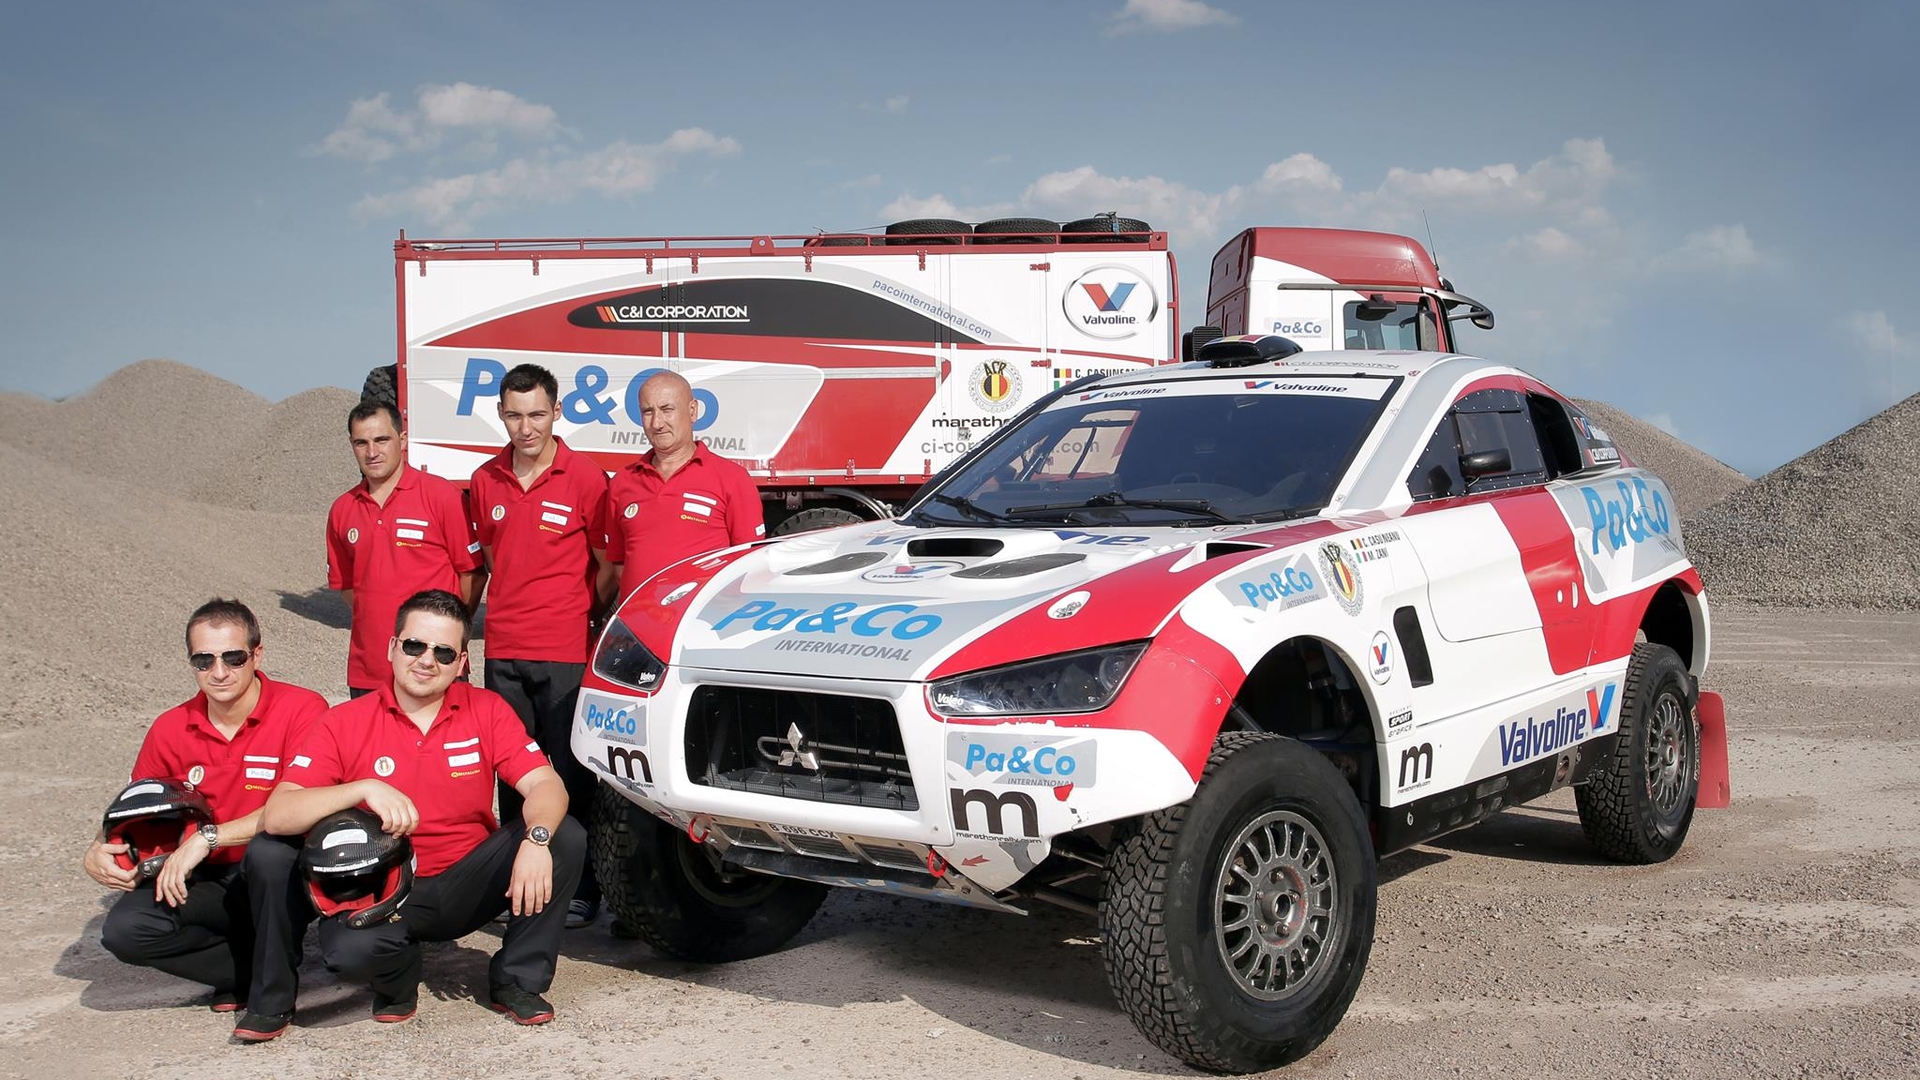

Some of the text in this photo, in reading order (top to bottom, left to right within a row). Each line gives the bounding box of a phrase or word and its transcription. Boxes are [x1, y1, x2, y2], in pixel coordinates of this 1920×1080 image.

[620, 305, 748, 319] C&I CORPORATION
[872, 278, 992, 340] pacointernational.com
[1082, 314, 1136, 326] Valvoline
[1273, 321, 1322, 334] Pa&Co
[456, 357, 719, 432] P&Co
[1103, 387, 1167, 399] Valvoline
[1274, 383, 1348, 393] Valvoline
[1580, 476, 1669, 555] Pa&Co
[1239, 566, 1314, 608] Pa&Co
[711, 600, 944, 641] Pa&Co
[774, 639, 914, 662] INTERNATIONAL
[937, 692, 965, 706] Valeo
[586, 703, 637, 736] Pa&Co
[1499, 707, 1587, 767] Valvoline
[965, 743, 1076, 776] Pa&Co
[1398, 742, 1434, 788] m
[950, 788, 1040, 838] m
[808, 828, 840, 840] CCX
